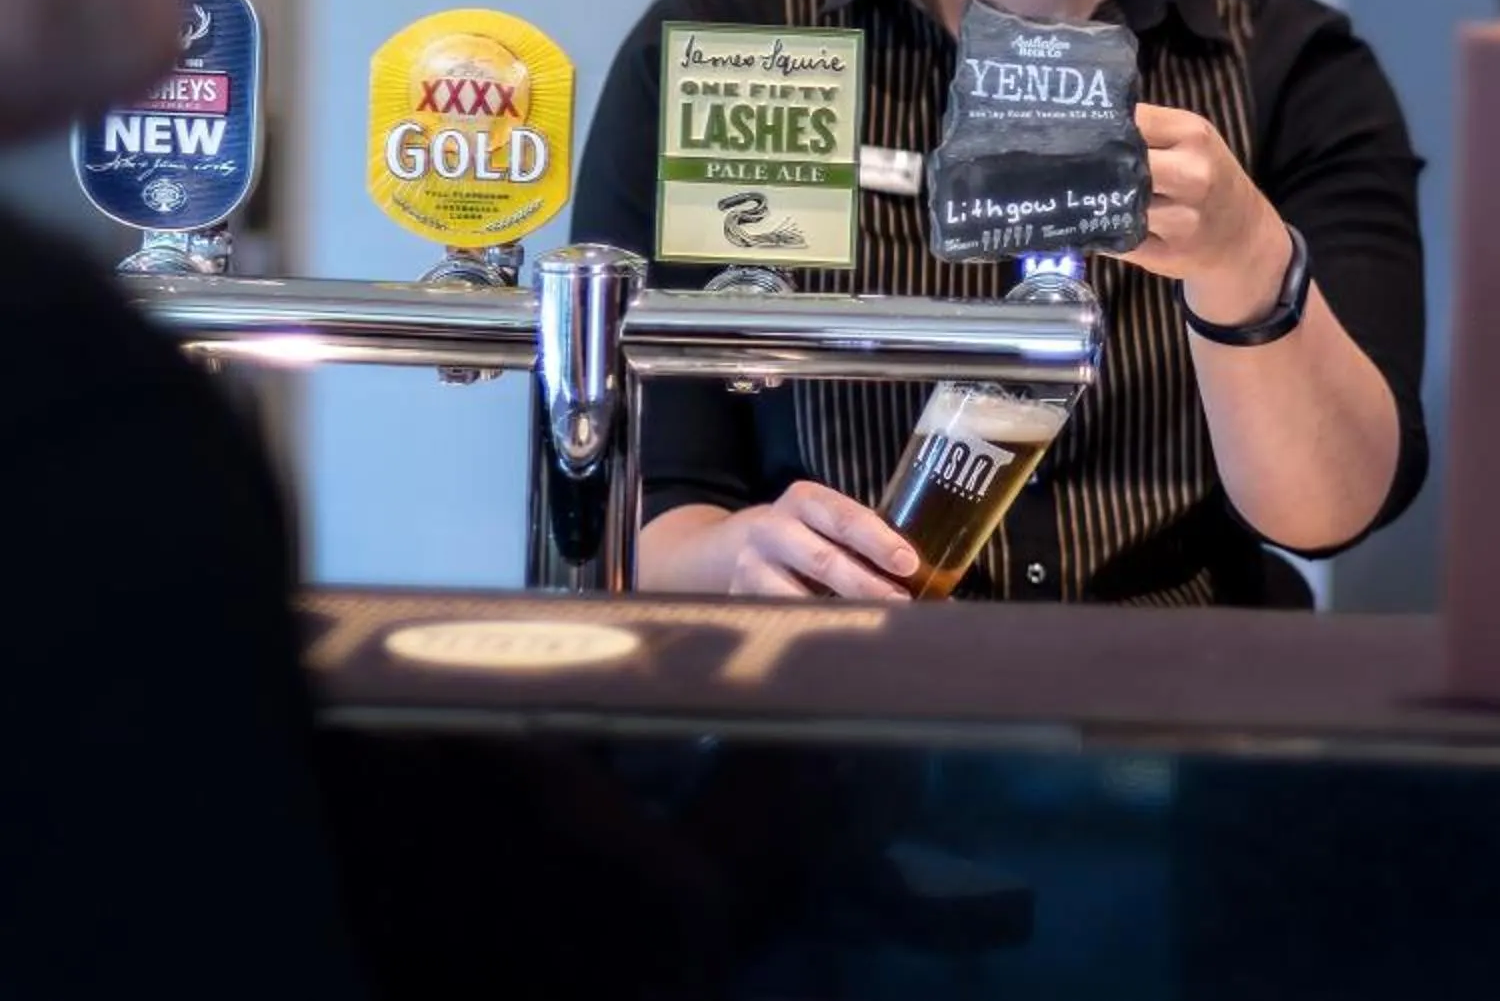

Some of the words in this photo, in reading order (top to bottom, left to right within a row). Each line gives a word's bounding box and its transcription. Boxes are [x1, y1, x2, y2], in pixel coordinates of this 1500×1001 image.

[681, 35, 756, 68] James
[761, 39, 846, 76] Squire
[416, 78, 521, 118] XXXX
[680, 80, 739, 98] ONE
[749, 83, 840, 101] FIFTY
[965, 59, 1113, 108] YENDA
[103, 115, 227, 155] NEW
[679, 102, 838, 155] LASHES
[385, 120, 549, 184] GOLD
[706, 163, 769, 180] PALE
[776, 165, 826, 182] ALE
[946, 198, 1057, 224] Lithgow
[1066, 189, 1137, 216] Lager
